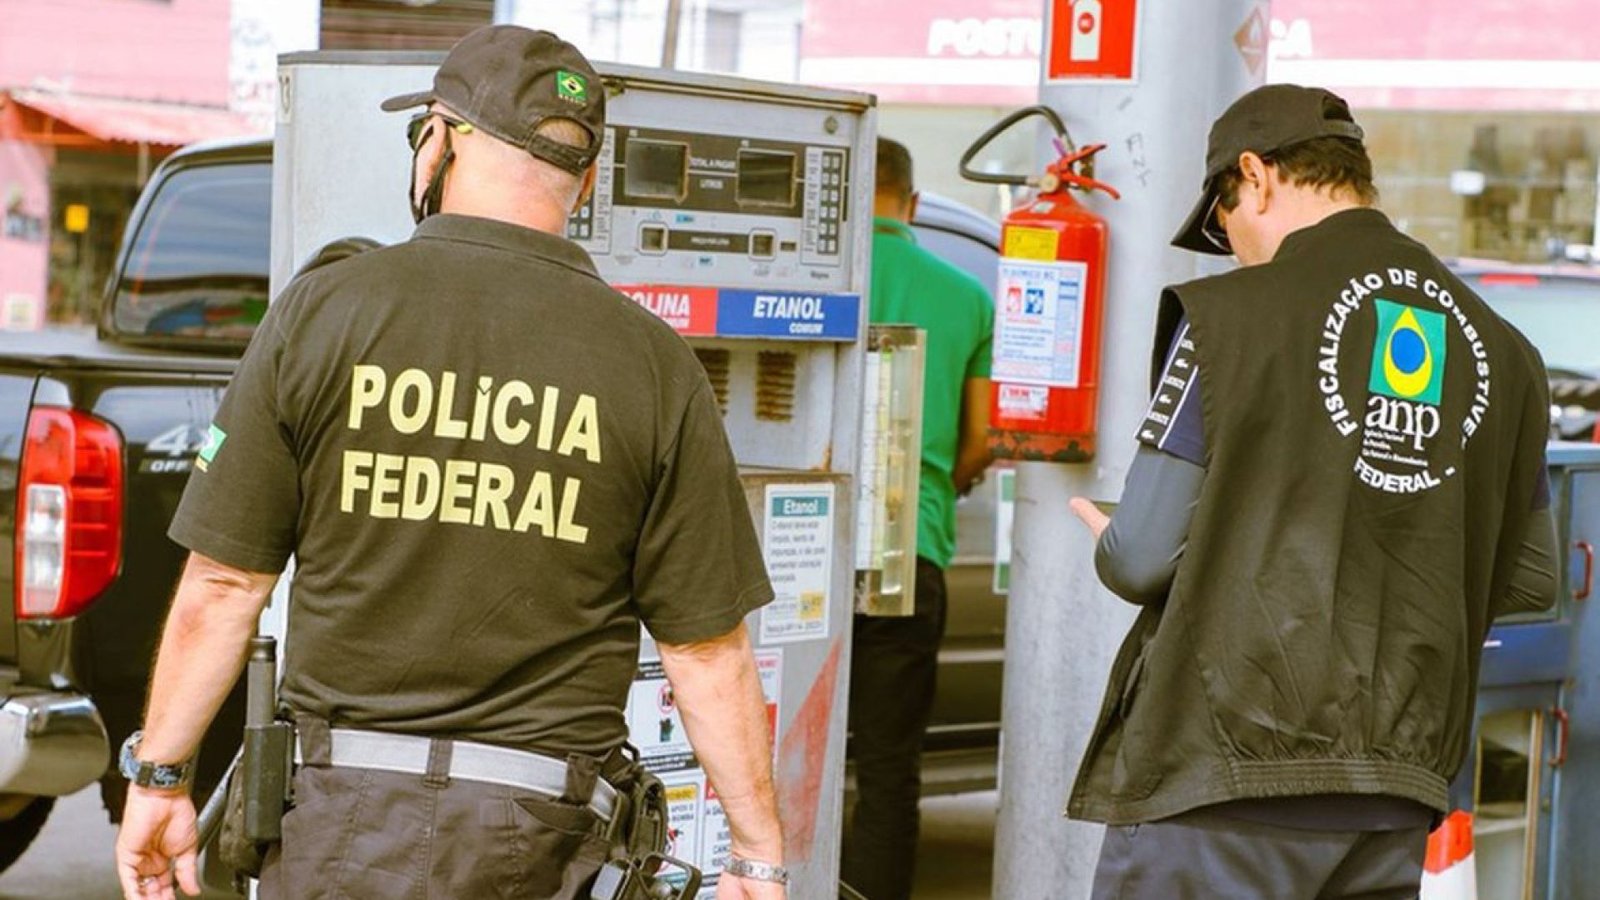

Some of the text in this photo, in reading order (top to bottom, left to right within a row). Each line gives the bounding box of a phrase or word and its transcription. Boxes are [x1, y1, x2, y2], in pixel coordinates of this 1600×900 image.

[753, 295, 825, 320] ETANOL
[1318, 268, 1490, 450] FISCALIZAÇÃO DE COMBUSTIVE
[1365, 396, 1441, 451] anp
[150, 459, 189, 473] OFF
[1354, 456, 1441, 493] FEDERAL
[340, 449, 590, 544] FEDERAL
[783, 498, 818, 515] Etanol
